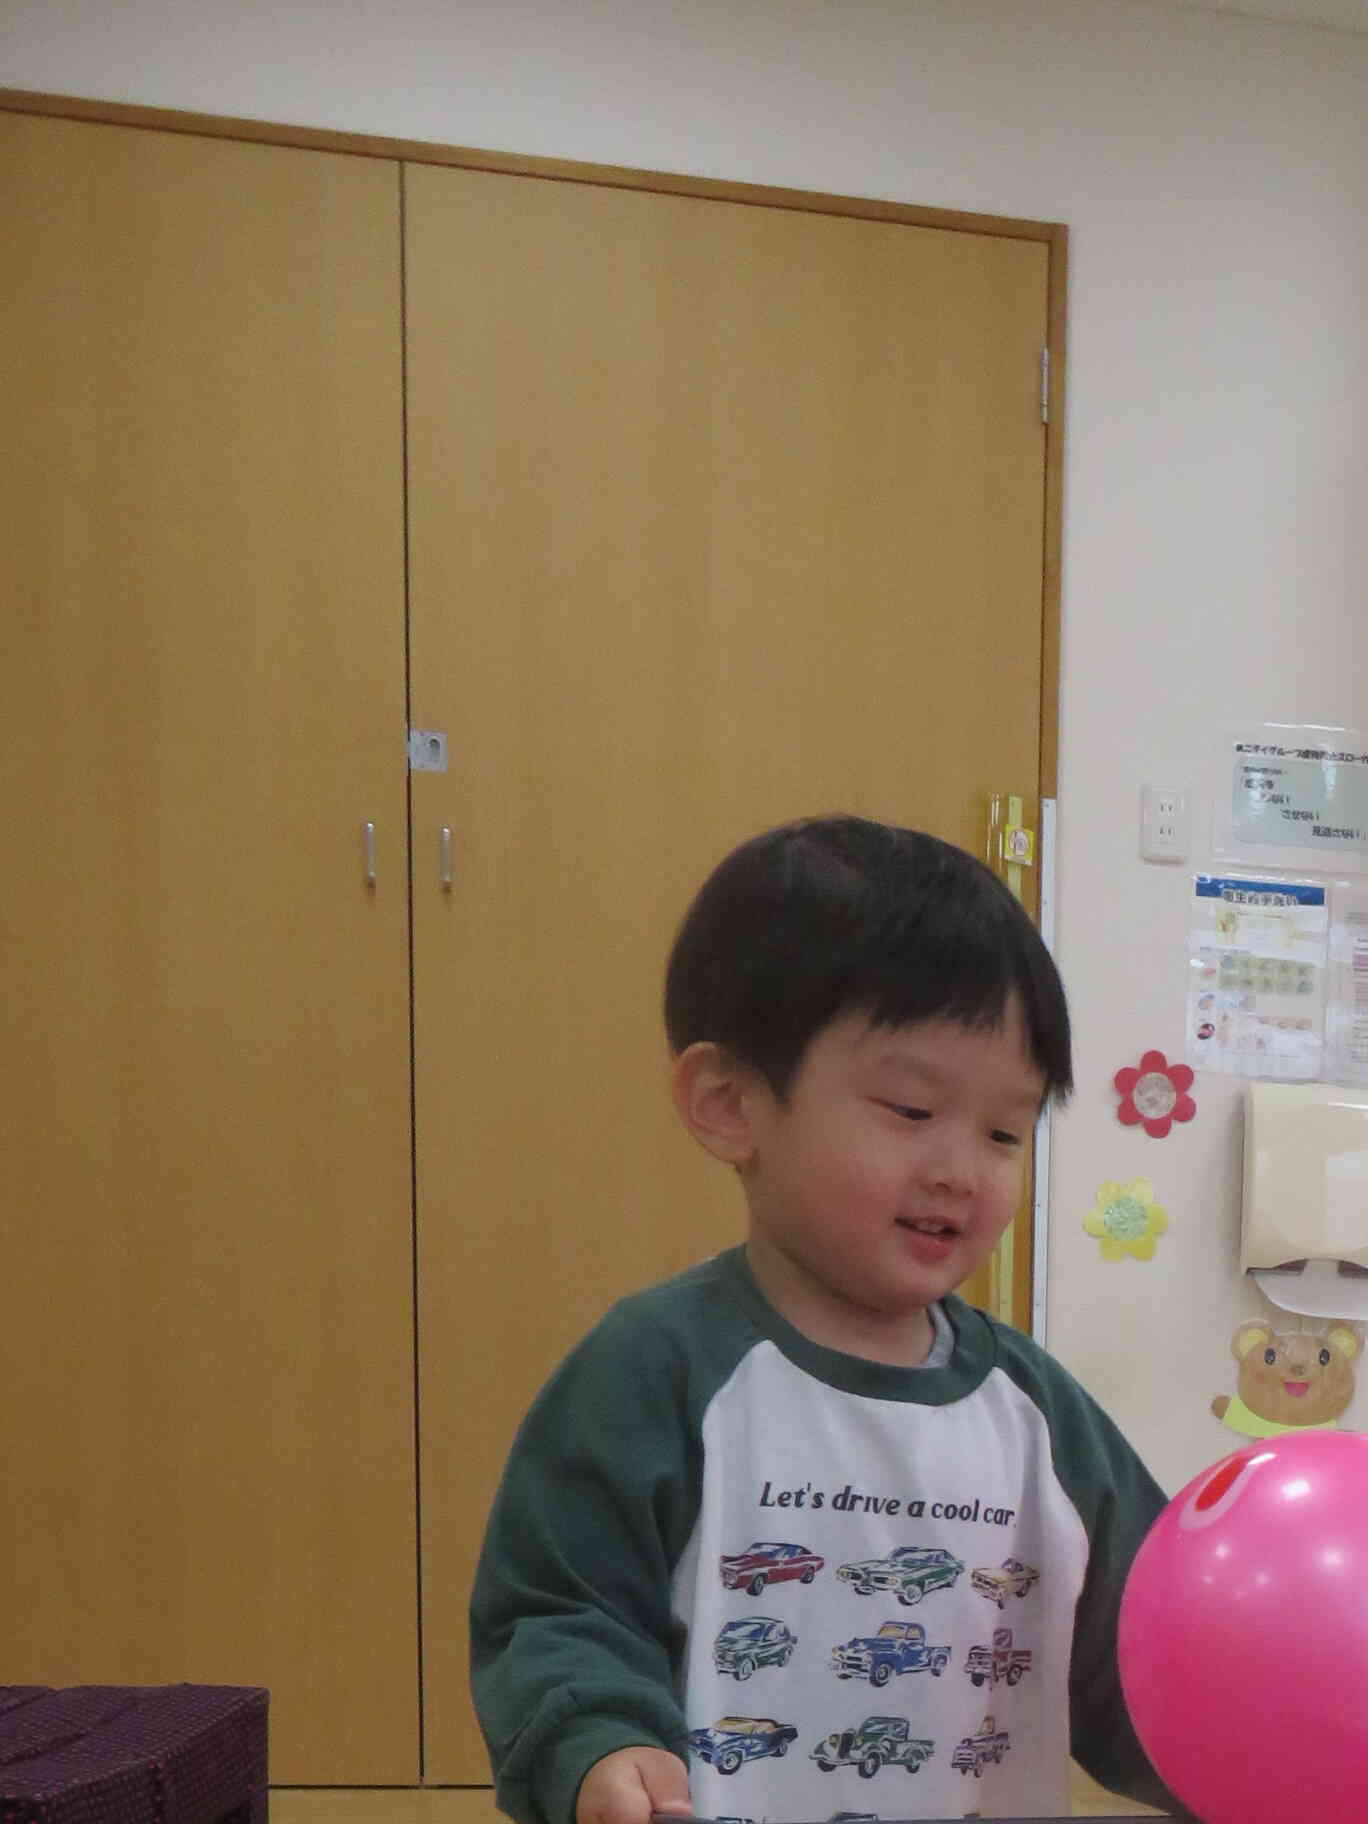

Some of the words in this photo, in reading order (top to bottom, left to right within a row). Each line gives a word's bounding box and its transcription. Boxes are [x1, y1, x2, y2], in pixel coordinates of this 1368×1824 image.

[759, 1481, 825, 1509] Let's
[831, 1485, 901, 1516] drive
[906, 1501, 925, 1518] a
[930, 1499, 979, 1523] cool
